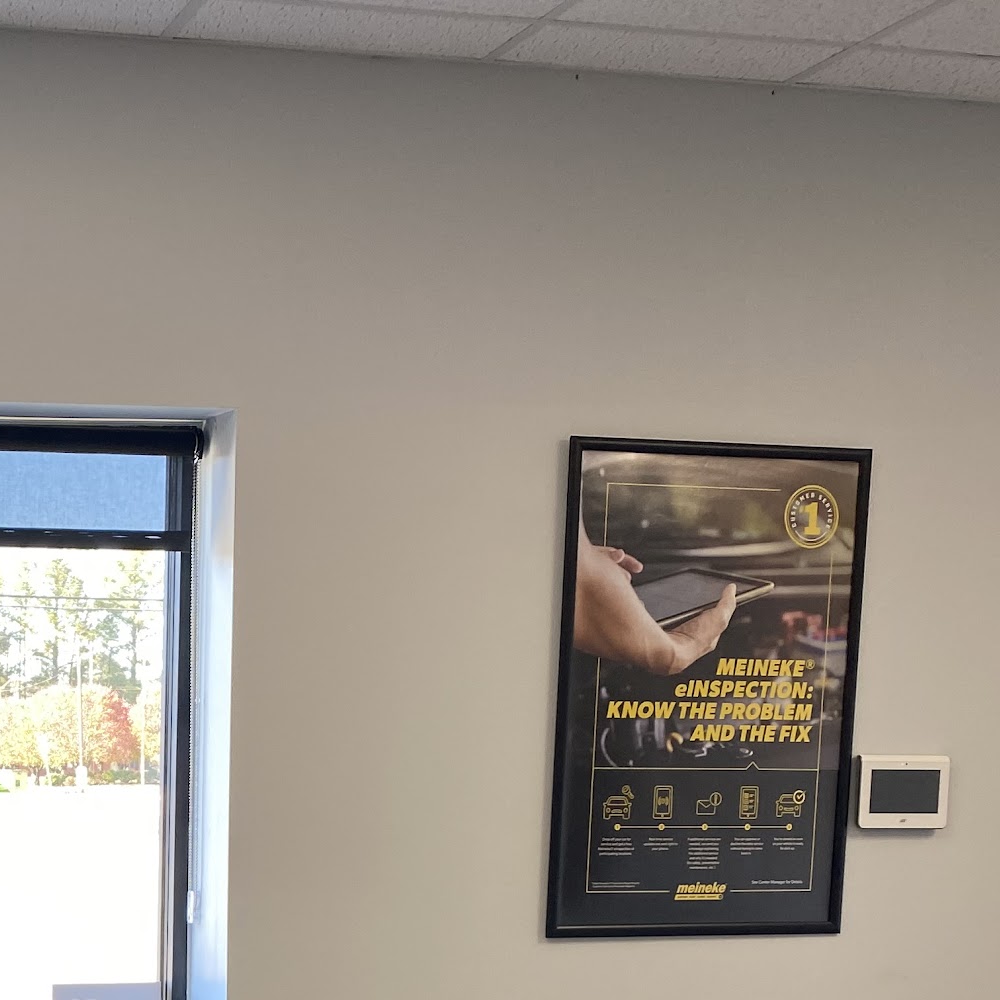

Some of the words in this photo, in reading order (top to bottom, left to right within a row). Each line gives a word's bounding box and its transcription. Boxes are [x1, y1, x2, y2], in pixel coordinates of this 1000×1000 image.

[790, 492, 815, 528] CUSTOMER
[818, 494, 833, 529] SERVICE
[802, 501, 820, 536] 1
[674, 679, 814, 699] eINSPECTION:
[606, 701, 676, 719] KNOW
[678, 702, 718, 720] THE
[719, 702, 813, 721] PROBLEM
[690, 724, 735, 742] AND
[738, 725, 778, 743] THE
[778, 725, 812, 743] FIX
[676, 881, 727, 894] meineke
